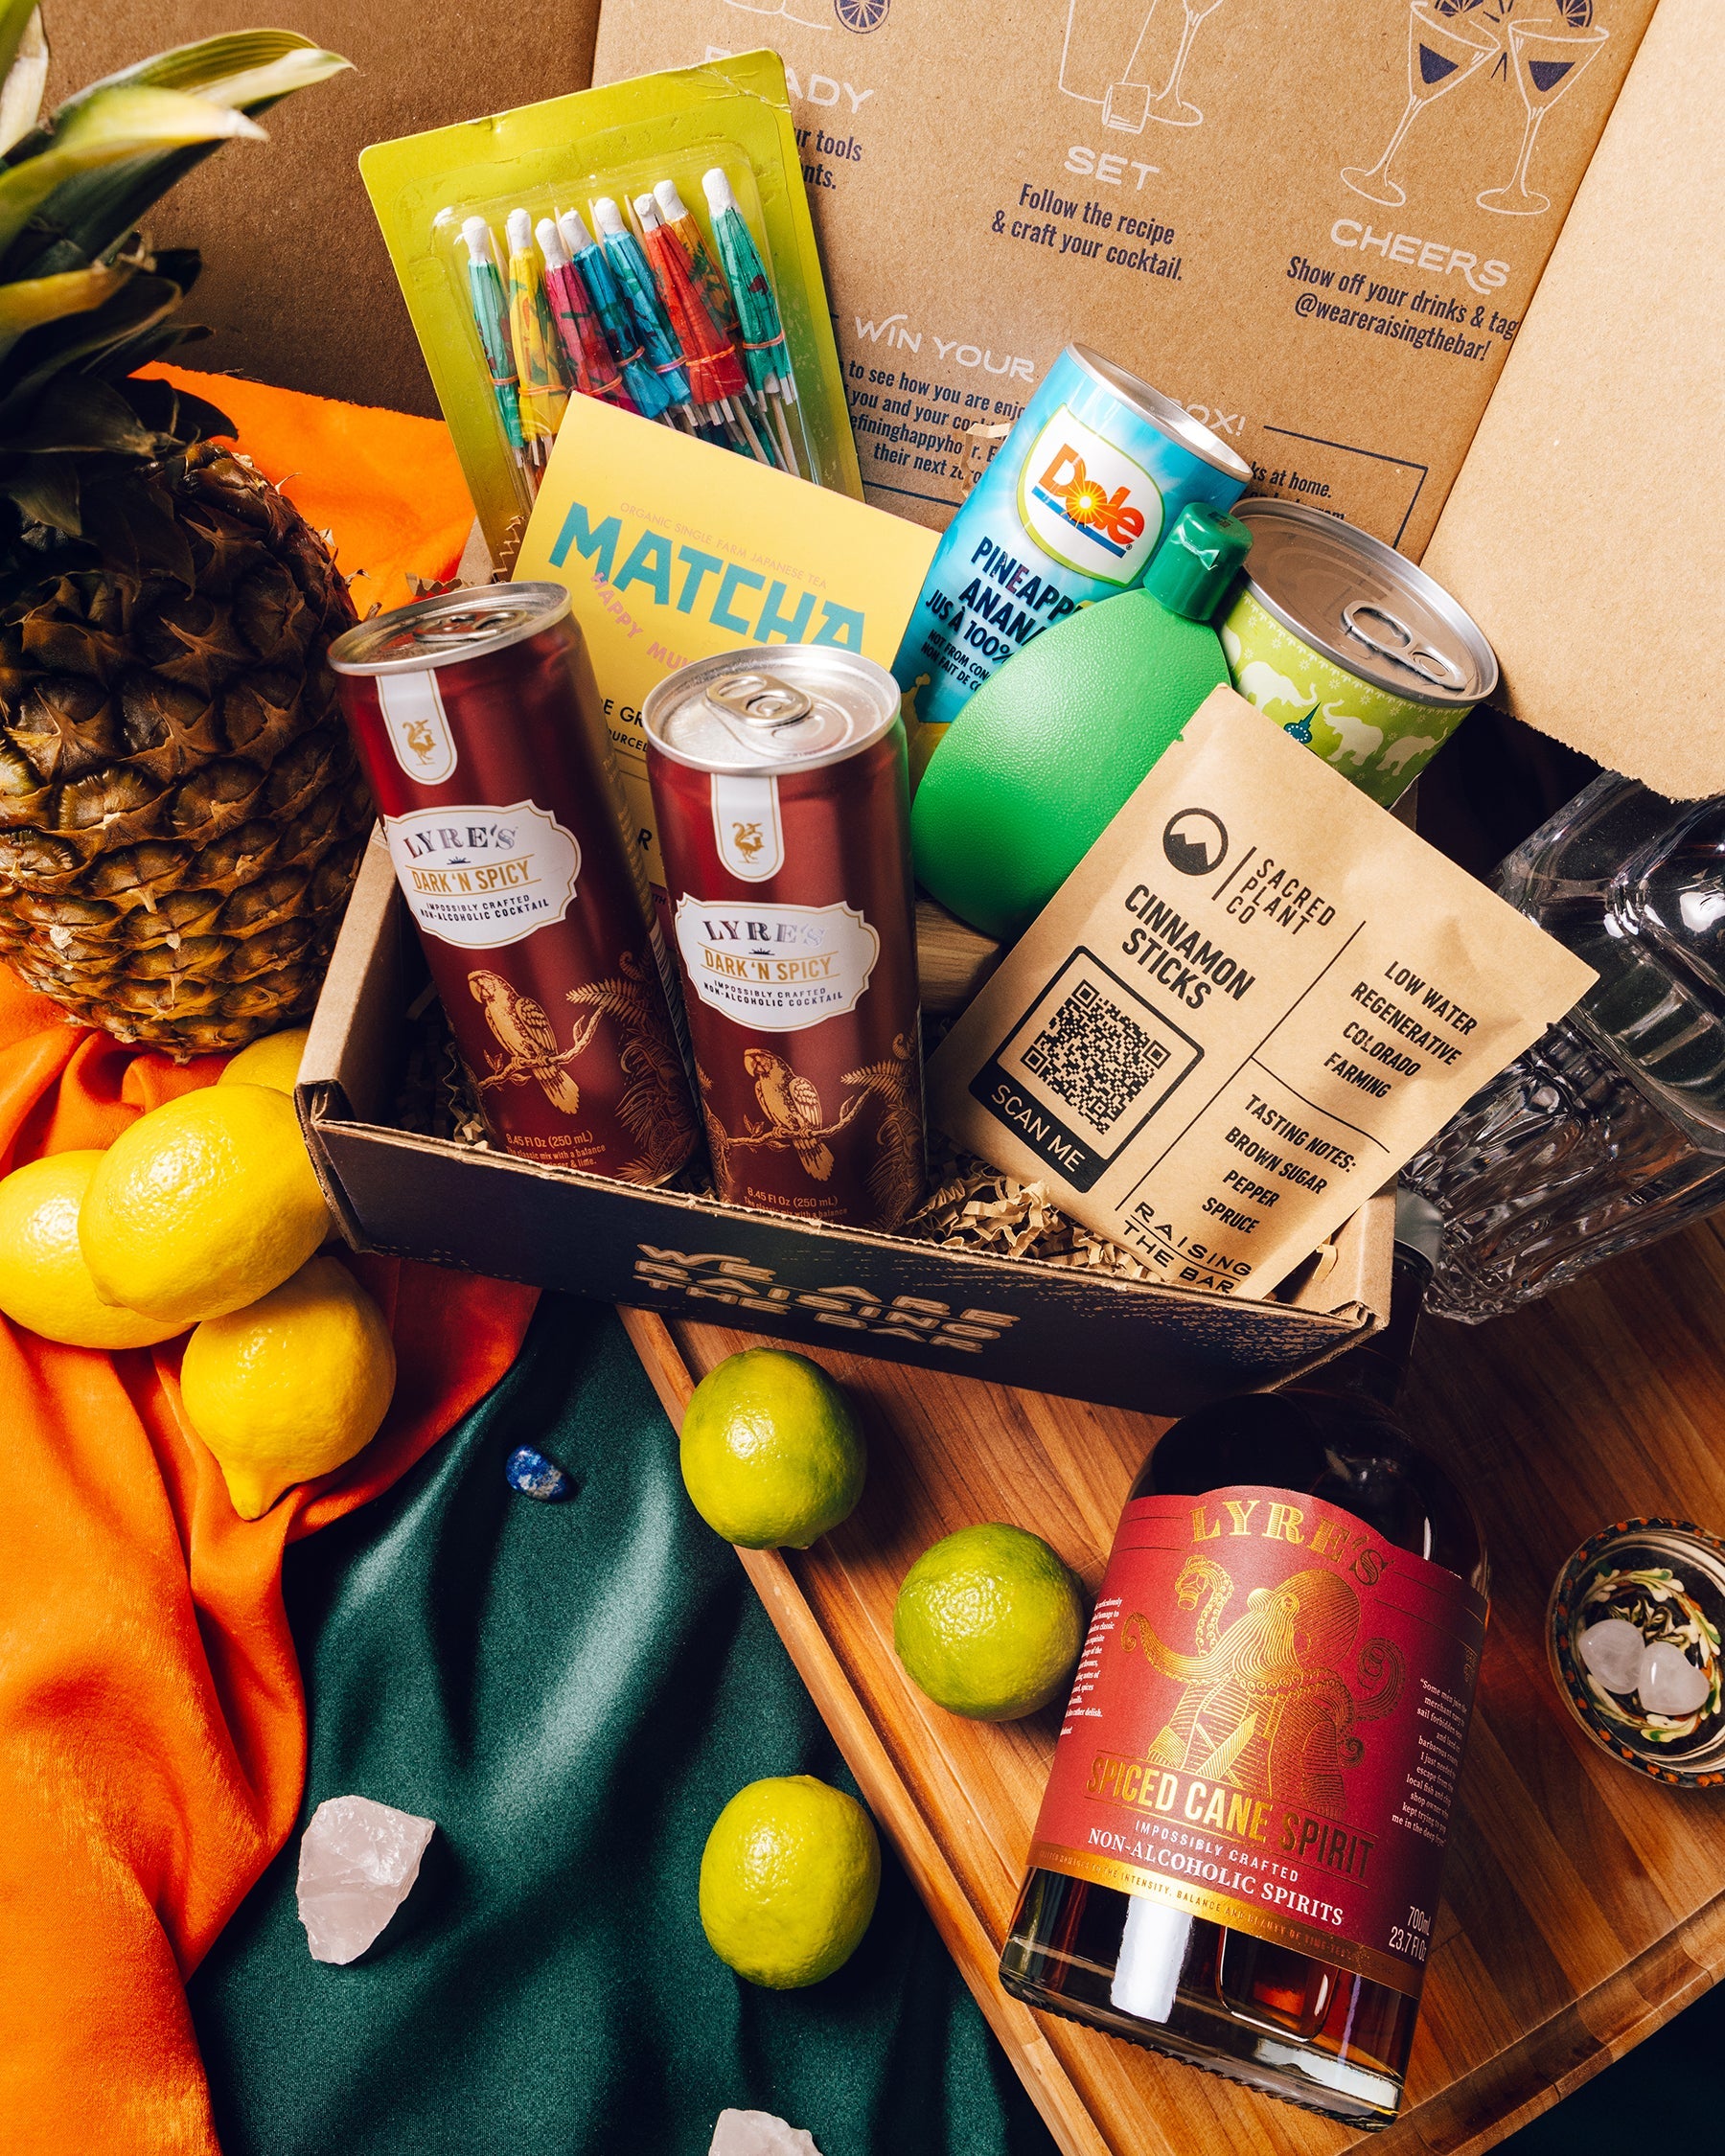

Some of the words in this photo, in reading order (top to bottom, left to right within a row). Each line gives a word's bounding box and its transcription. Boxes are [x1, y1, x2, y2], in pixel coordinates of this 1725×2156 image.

[704, 45, 874, 114] ADY
[816, 129, 862, 162] tools
[1064, 146, 1161, 191] SET
[1019, 183, 1078, 219] Follow
[1082, 201, 1113, 229] the
[1116, 215, 1175, 246] recipe
[991, 210, 1005, 234] &
[1011, 219, 1057, 247] craft
[1059, 232, 1103, 259] your
[1106, 245, 1183, 281] cocktail.
[1330, 218, 1510, 295] CHEERS
[1286, 256, 1335, 287] Show
[1338, 272, 1366, 295] off
[1365, 283, 1409, 308] your
[1411, 289, 1468, 323] drinks
[1470, 305, 1485, 328] &
[1488, 310, 1520, 340] tag
[855, 314, 922, 353] WIN
[932, 336, 1034, 382] YOUR
[1295, 292, 1491, 361] @weareraisingthebar!
[849, 360, 864, 379] to
[868, 369, 895, 387] see
[898, 372, 930, 396] how
[934, 383, 961, 404] you
[965, 394, 990, 411] are
[850, 390, 879, 409] you
[882, 399, 912, 417] and
[913, 405, 950, 426] your
[873, 442, 911, 466] their
[913, 455, 948, 475] next
[1038, 443, 1145, 545] Dole
[1270, 470, 1286, 487] at
[1288, 471, 1331, 498] home.
[620, 501, 672, 530] ORGANIC
[674, 521, 713, 545] SINGLE
[716, 539, 748, 558] FARM
[750, 552, 805, 580] JAPANESE
[807, 572, 828, 589] TEA
[548, 501, 865, 654] MATCHA
[971, 536, 1082, 622] PINEAPP
[589, 572, 643, 639] HAPPY
[925, 589, 954, 621] JUS
[921, 641, 938, 662] NON
[938, 656, 958, 677] FAIT
[955, 669, 971, 685] DE
[928, 629, 945, 647] NOT
[945, 643, 970, 668] FROM
[403, 824, 518, 860] LYRE'S
[411, 870, 453, 893] DARK
[474, 860, 530, 890] SPICY
[1256, 859, 1336, 927] SACRED
[420, 907, 491, 922] NON-ALCOHOLIC
[494, 898, 550, 919] COCKTAIL
[426, 902, 479, 912] IMPOSSIBLY
[482, 894, 531, 910] CRAFTED
[1226, 895, 1256, 925] CO
[1239, 876, 1310, 935] PLANT
[702, 920, 826, 947] LYRE'S
[1124, 883, 1256, 1001] CINNAMON
[704, 949, 748, 978] DARK
[777, 956, 832, 981] SPICY
[1121, 928, 1212, 1010] STICKS
[703, 982, 784, 1007] NON-ALCOHOLIC
[789, 991, 843, 1007] COCKTAIL
[713, 979, 772, 998] IMPOSSIBLY
[777, 987, 827, 998] CRAFTED
[1383, 960, 1426, 997] LOW
[1421, 987, 1479, 1037] WATER
[1349, 980, 1462, 1067] REGENERATIVE
[1342, 1021, 1422, 1078] COLORADO
[1322, 1051, 1392, 1099] FARMING
[505, 1133, 524, 1146] 8.45
[534, 1136, 547, 1148] Oz
[547, 1135, 573, 1149] (250
[573, 1130, 593, 1145] mL)
[552, 1150, 569, 1159] with
[575, 1144, 607, 1157] balance
[991, 1084, 1051, 1143] SCAN
[1046, 1134, 1086, 1174] ME
[1244, 1093, 1310, 1147] TASTING
[1305, 1137, 1357, 1174] NOTES:
[578, 1158, 596, 1167] lime.
[1224, 1125, 1282, 1173] BROWN
[1277, 1161, 1328, 1195] SUGAR
[748, 1186, 767, 1202] 8.45
[768, 1194, 776, 1204] Fl
[778, 1196, 791, 1206] Oz
[793, 1196, 817, 1208] (250
[818, 1195, 839, 1207] mL)
[1222, 1169, 1281, 1208] PEPPER
[818, 1207, 848, 1218] balance
[1201, 1197, 1261, 1234] SPRUCE
[1124, 1220, 1175, 1269] THE
[1180, 1266, 1235, 1294] BAR
[1134, 1201, 1253, 1277] RAISING
[634, 1260, 1001, 1341] RAISING
[636, 1243, 777, 1282] WE
[816, 1285, 1022, 1329] ARE
[632, 1274, 792, 1316] THE
[814, 1312, 984, 1354] BAR
[1189, 1501, 1390, 1587] LYRE'S
[1416, 1708, 1431, 1719] sail
[1406, 1774, 1423, 1789] local
[1423, 1754, 1437, 1766] just
[1086, 1755, 1179, 1812] SPICED
[1184, 1779, 1274, 1845] CANE
[1277, 1811, 1376, 1880] SPIRIT
[1402, 1801, 1418, 1817] kept
[1410, 1792, 1426, 1807] shop
[1392, 1814, 1404, 1825] me
[1404, 1818, 1412, 1829] in
[1413, 1823, 1423, 1834] the
[1135, 1820, 1222, 1857] IMPOSSIBLY
[1229, 1848, 1300, 1884] CRAFTED
[1087, 1827, 1255, 1896] NON-ALCOHOLIC
[1260, 1881, 1344, 1927] SPIRITS
[1176, 1890, 1221, 1913] BALANCE
[1407, 1906, 1432, 1937] 700mL
[1389, 1926, 1411, 1954] 23.7
